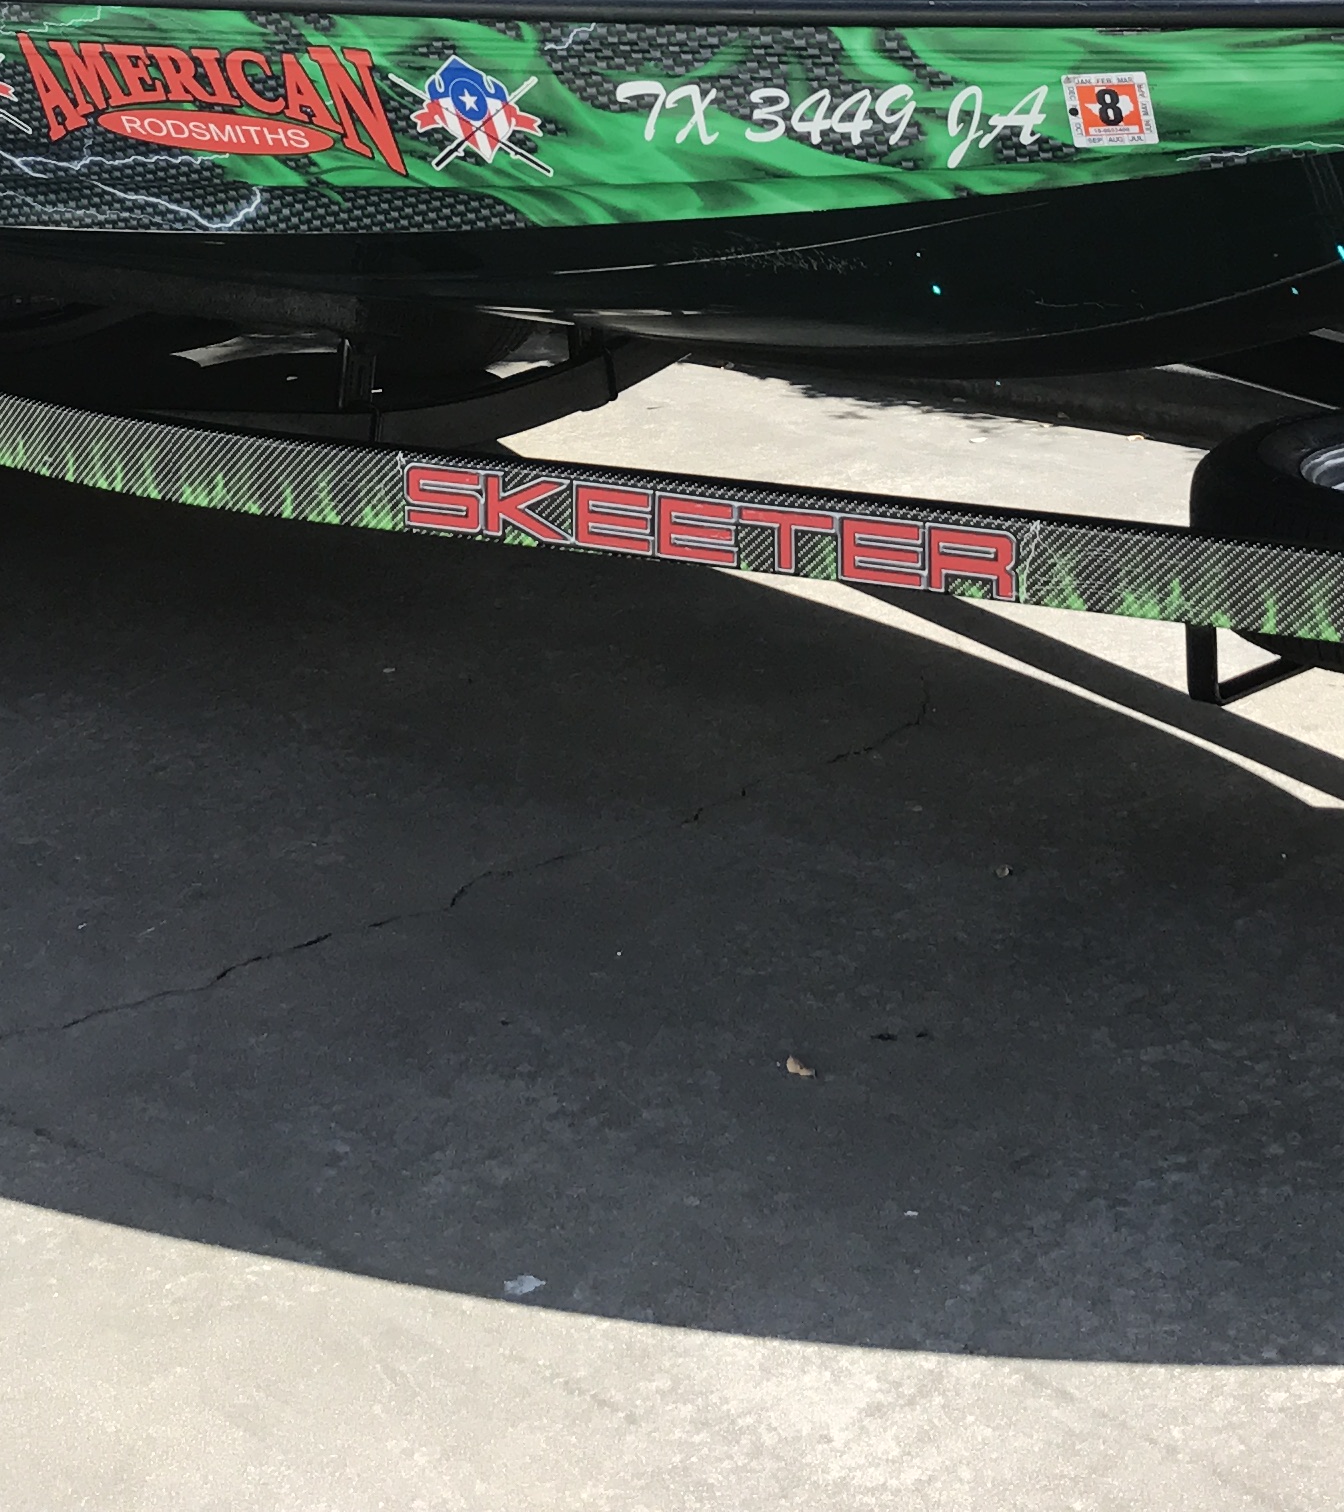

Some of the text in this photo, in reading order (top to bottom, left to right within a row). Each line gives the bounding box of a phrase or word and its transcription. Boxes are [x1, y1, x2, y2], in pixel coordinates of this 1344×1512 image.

[16, 31, 409, 176] AMERICAN
[120, 115, 310, 150] RODSMITHS
[616, 81, 1049, 169] TX 3449 JA
[1096, 89, 1123, 126] 8
[405, 463, 1017, 601] SKEETER
